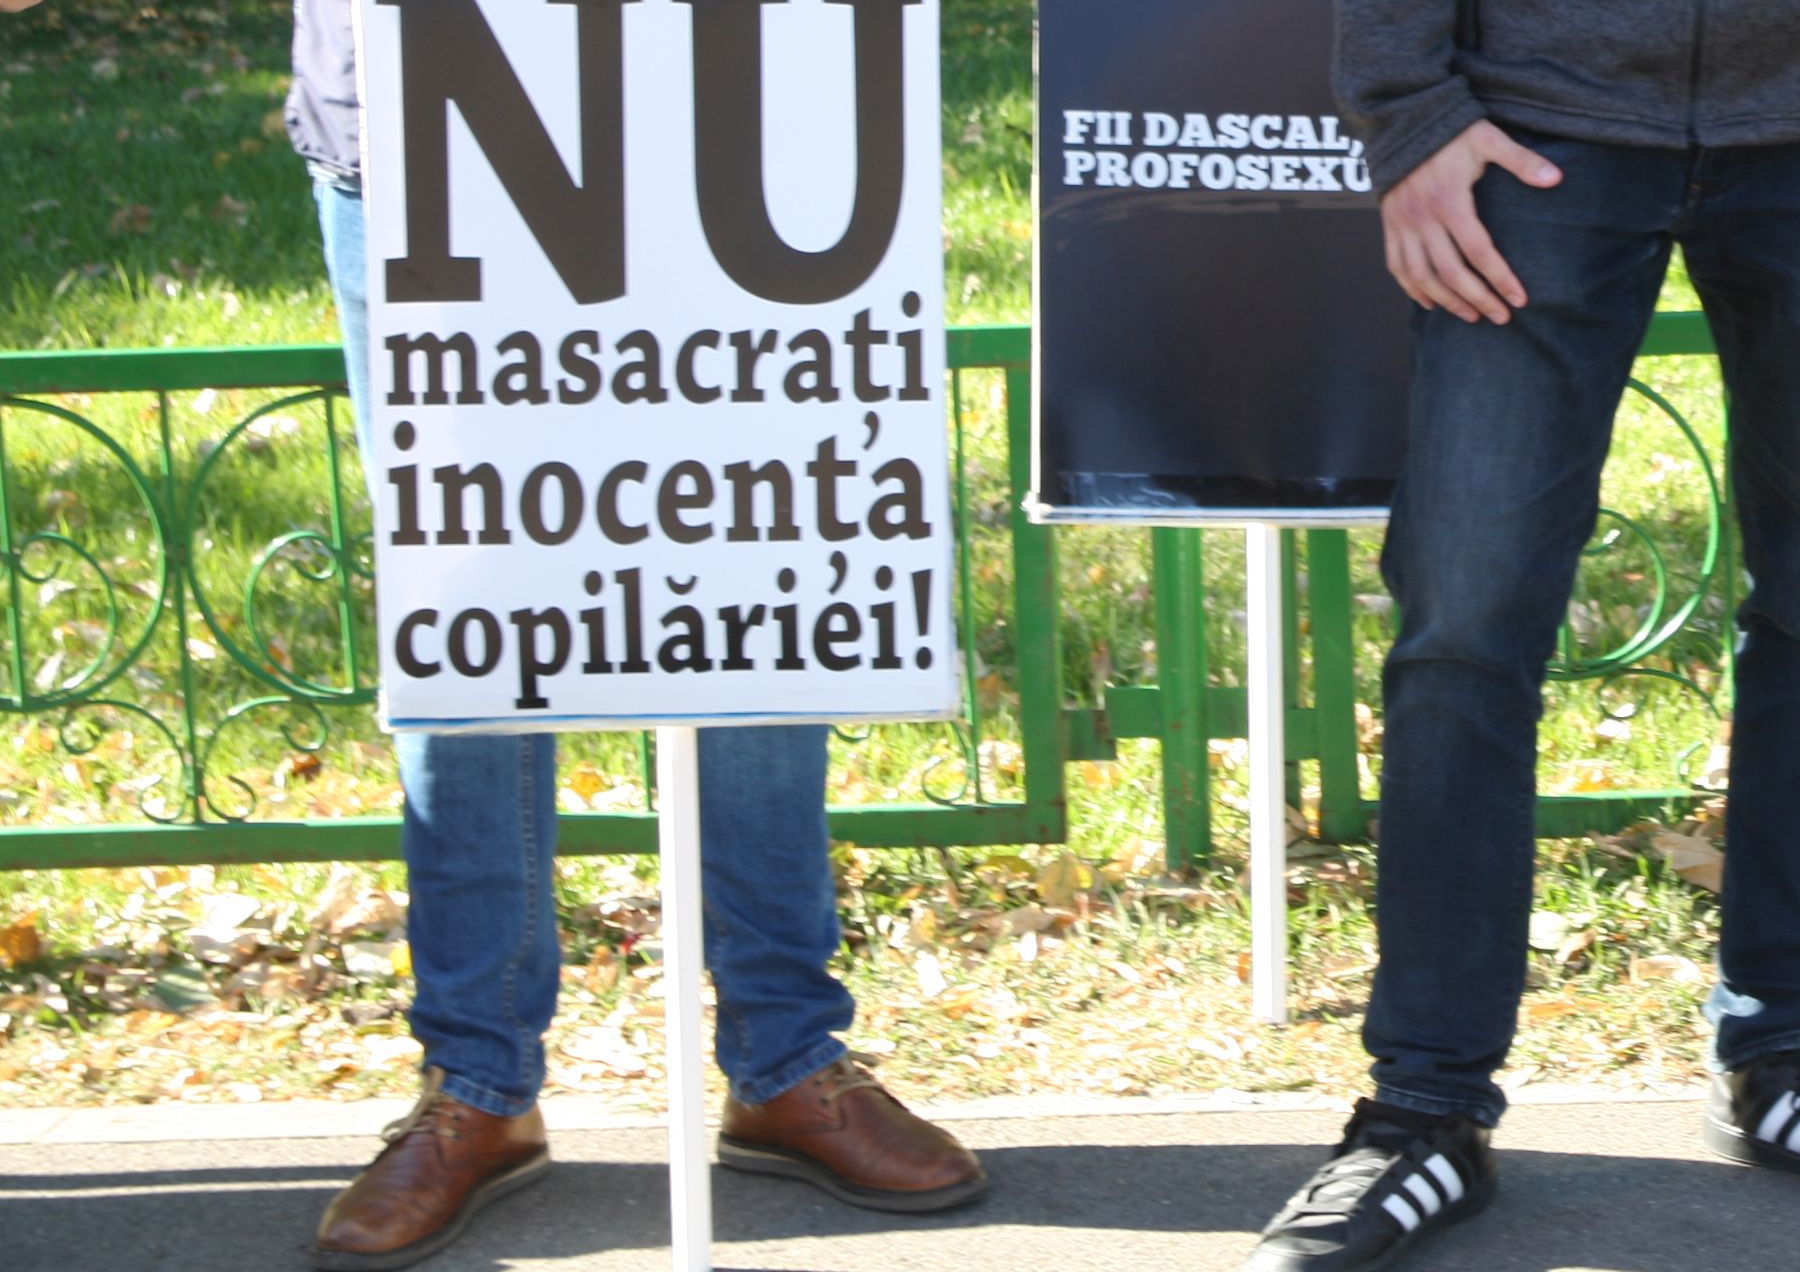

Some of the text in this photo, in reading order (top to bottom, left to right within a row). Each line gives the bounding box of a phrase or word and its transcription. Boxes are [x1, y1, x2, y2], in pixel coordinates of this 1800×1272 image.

[1063, 110, 1364, 158] FII DASCAL,
[1063, 150, 1373, 192] PROFOSEXU
